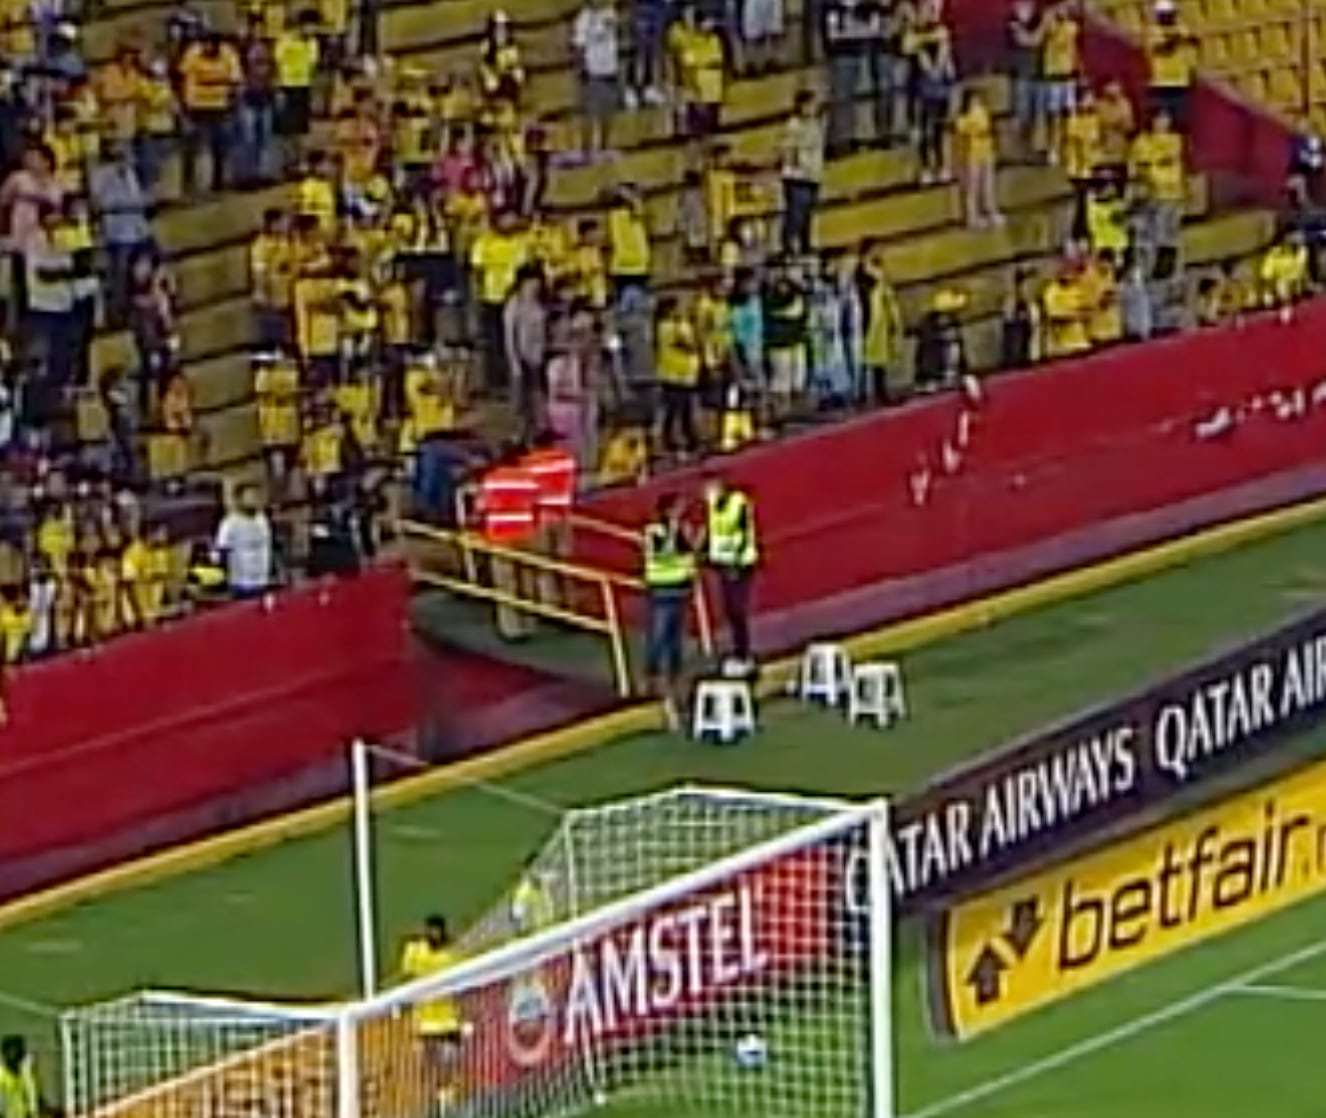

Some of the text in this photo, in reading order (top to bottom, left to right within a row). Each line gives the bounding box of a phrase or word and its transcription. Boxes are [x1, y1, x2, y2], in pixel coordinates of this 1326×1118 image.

[1156, 660, 1273, 778] QATAR
[979, 726, 1134, 858] AIRWAYS
[565, 880, 768, 1044] AMSTEL
